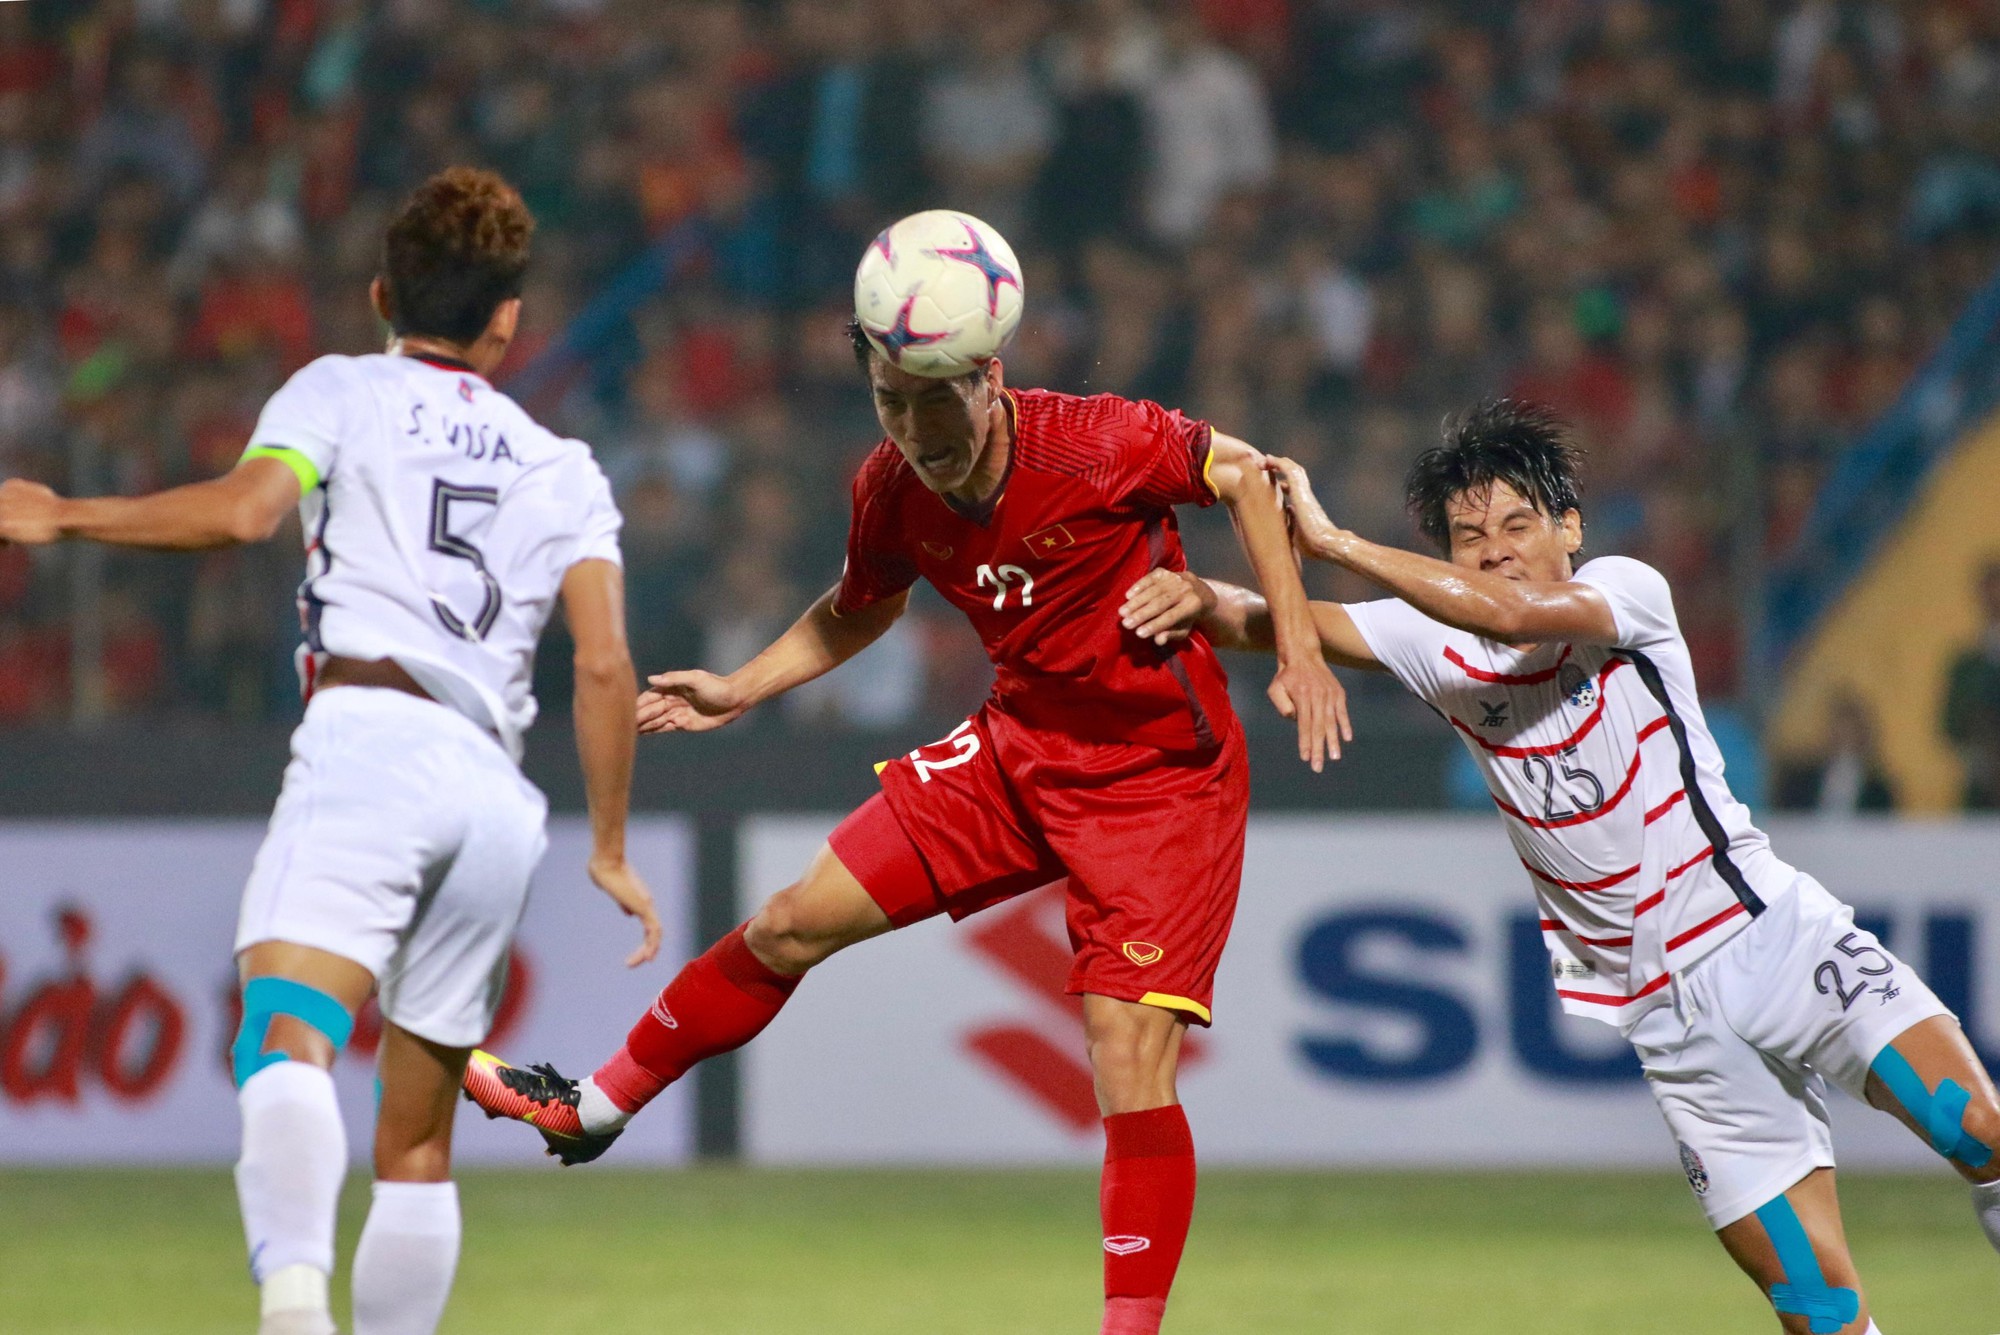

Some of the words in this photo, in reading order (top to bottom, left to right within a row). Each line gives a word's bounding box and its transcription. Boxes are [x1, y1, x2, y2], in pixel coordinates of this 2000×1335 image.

[441, 413, 524, 466] VISA
[428, 477, 501, 640] 5
[1523, 746, 1605, 822] 25
[1813, 931, 1894, 1013] 25
